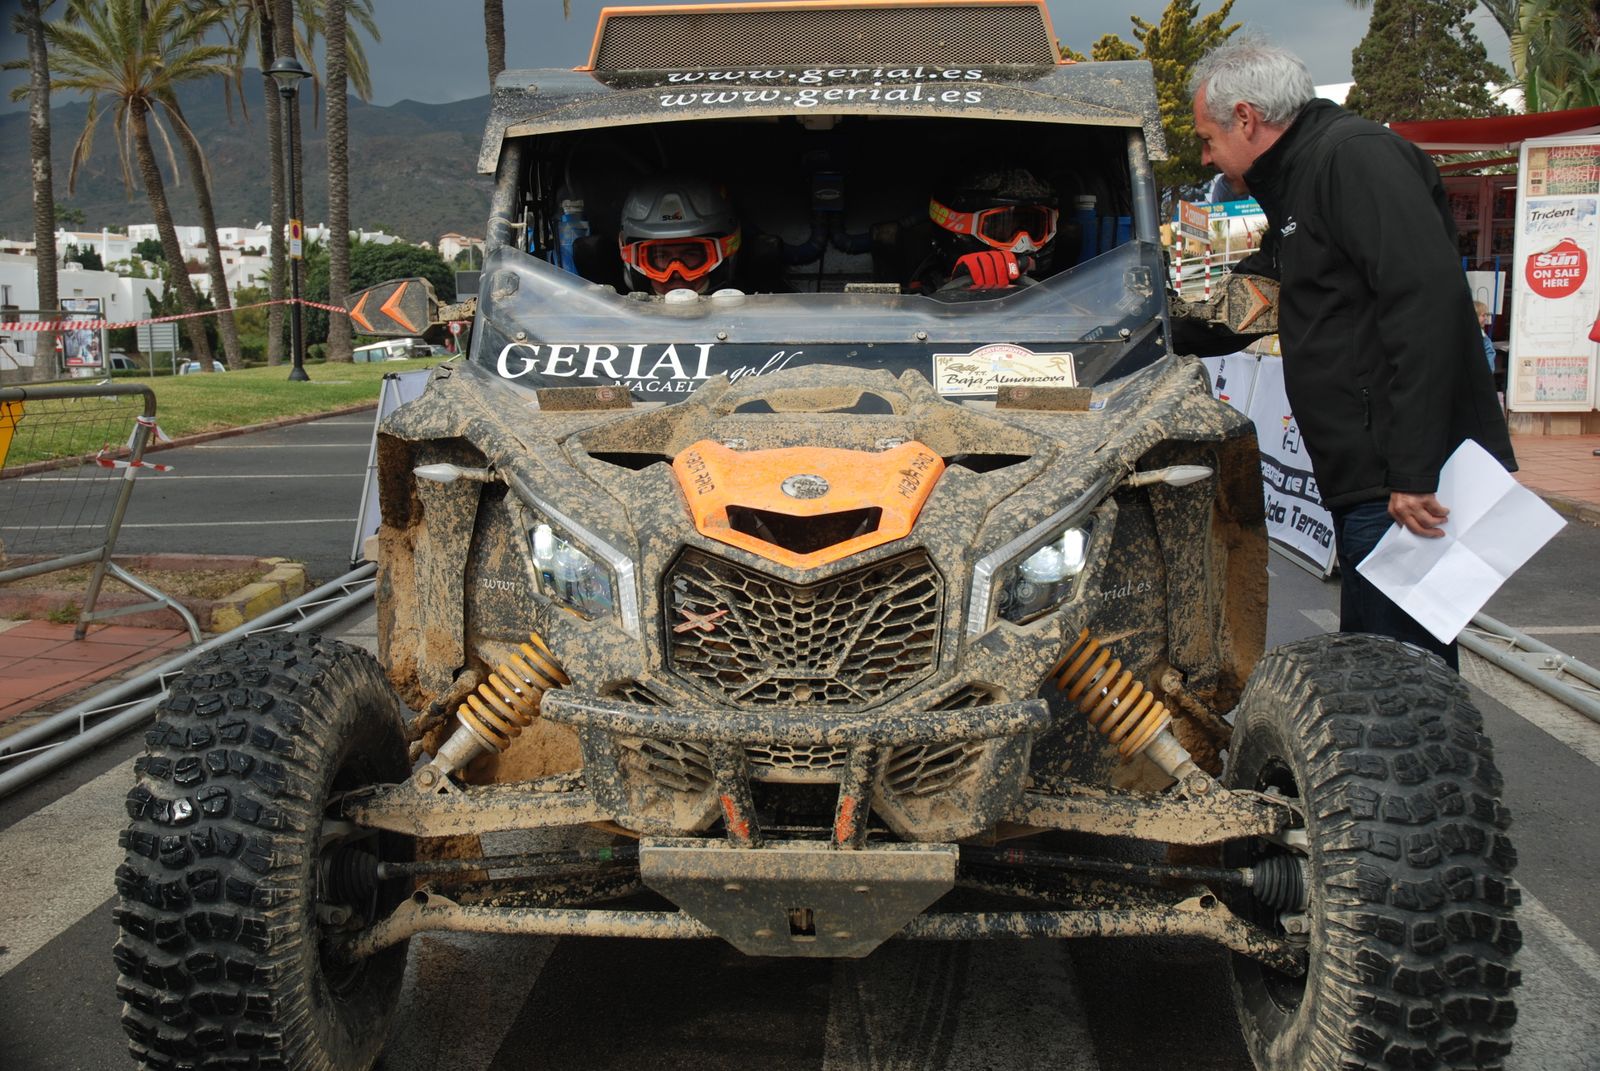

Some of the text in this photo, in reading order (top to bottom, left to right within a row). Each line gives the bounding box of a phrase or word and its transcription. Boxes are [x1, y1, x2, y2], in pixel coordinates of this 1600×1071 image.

[668, 66, 983, 84] www.gerial.es
[660, 82, 983, 107] www.gerial.es
[1531, 207, 1575, 221] Trident
[1535, 253, 1578, 267] Sun
[1533, 268, 1580, 279] ON SALE
[1543, 278, 1569, 288] HERE
[496, 342, 728, 380] GERIAL
[613, 379, 697, 393] MACAEL
[942, 373, 1065, 387] Baja Almanzora
